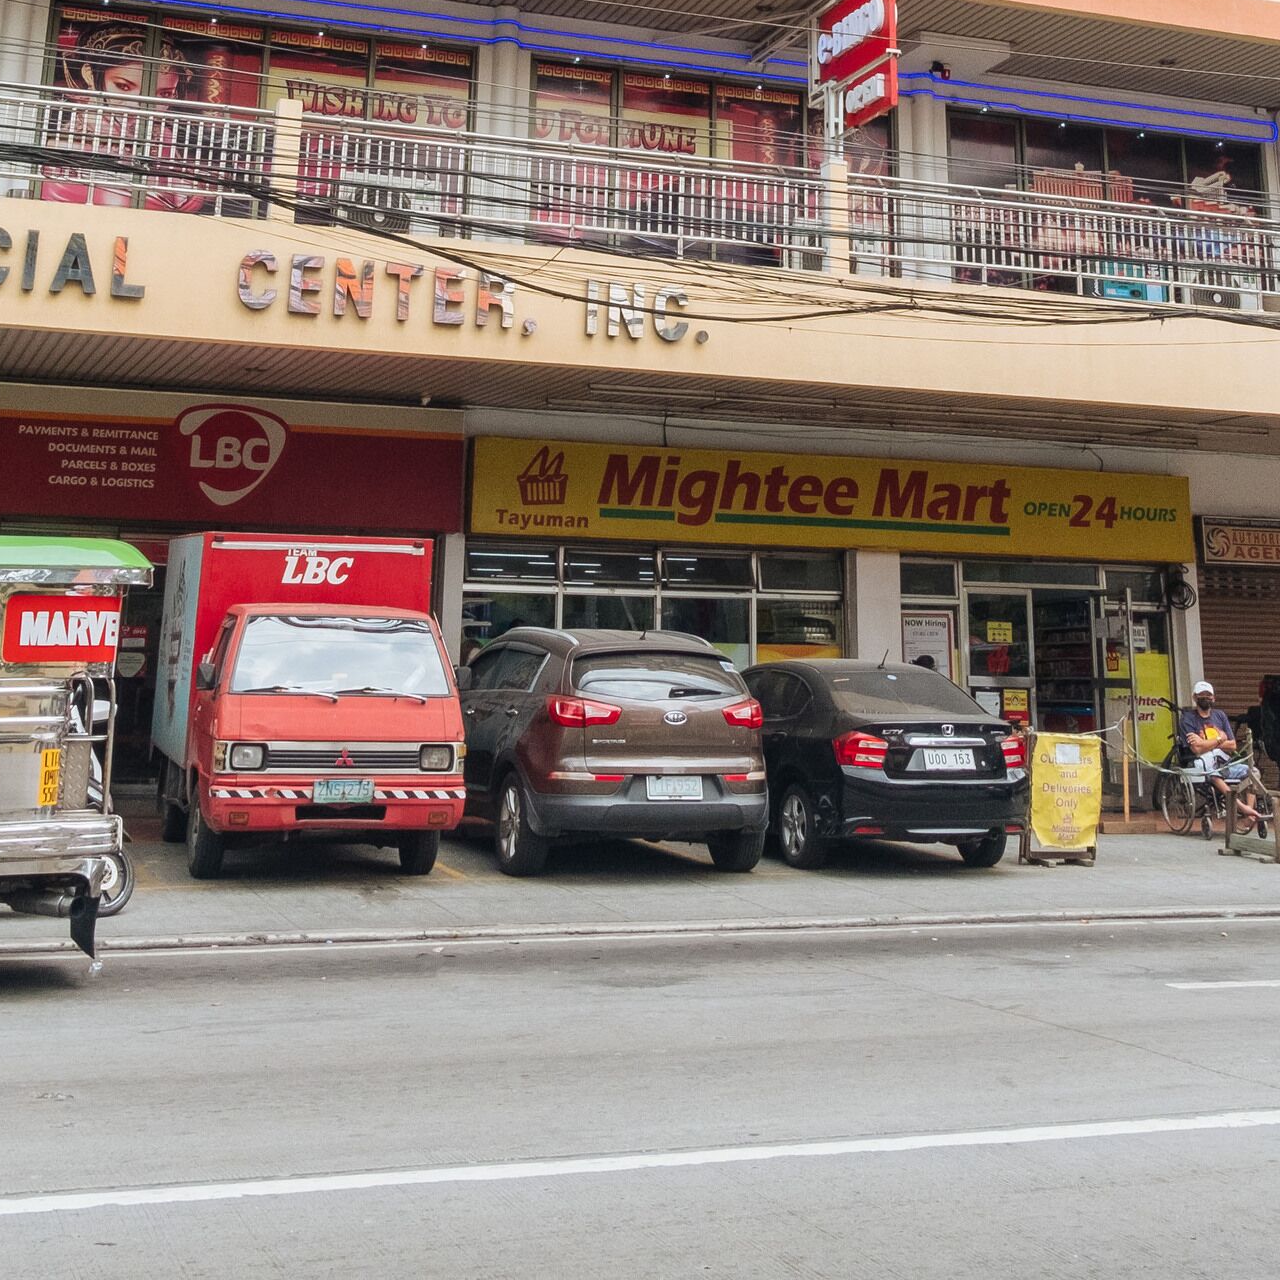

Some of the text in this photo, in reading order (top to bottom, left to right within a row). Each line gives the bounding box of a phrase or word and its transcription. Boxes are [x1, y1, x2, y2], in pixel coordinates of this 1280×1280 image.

[286, 79, 418, 124] WISHING
[585, 278, 709, 342] INC.
[18, 424, 160, 441] PAYMENTS & REMITTANCE
[48, 442, 158, 457] DOCUMENTS & MAIL
[189, 433, 271, 472] LBC
[61, 459, 156, 473] PARCELS & BOXES
[48, 475, 155, 489] CARGO & LOGISTICS
[597, 453, 1177, 529] Mightee Mart OPEN 24 HOURS
[495, 509, 589, 531] Tayuman
[287, 548, 318, 556] TEAM
[281, 556, 354, 584] LBC
[904, 619, 947, 629] NOW Hiring
[1059, 770, 1078, 779] and
[347, 783, 370, 797] 275
[1042, 782, 1092, 795] Deliveries
[1055, 798, 1078, 809] Only
